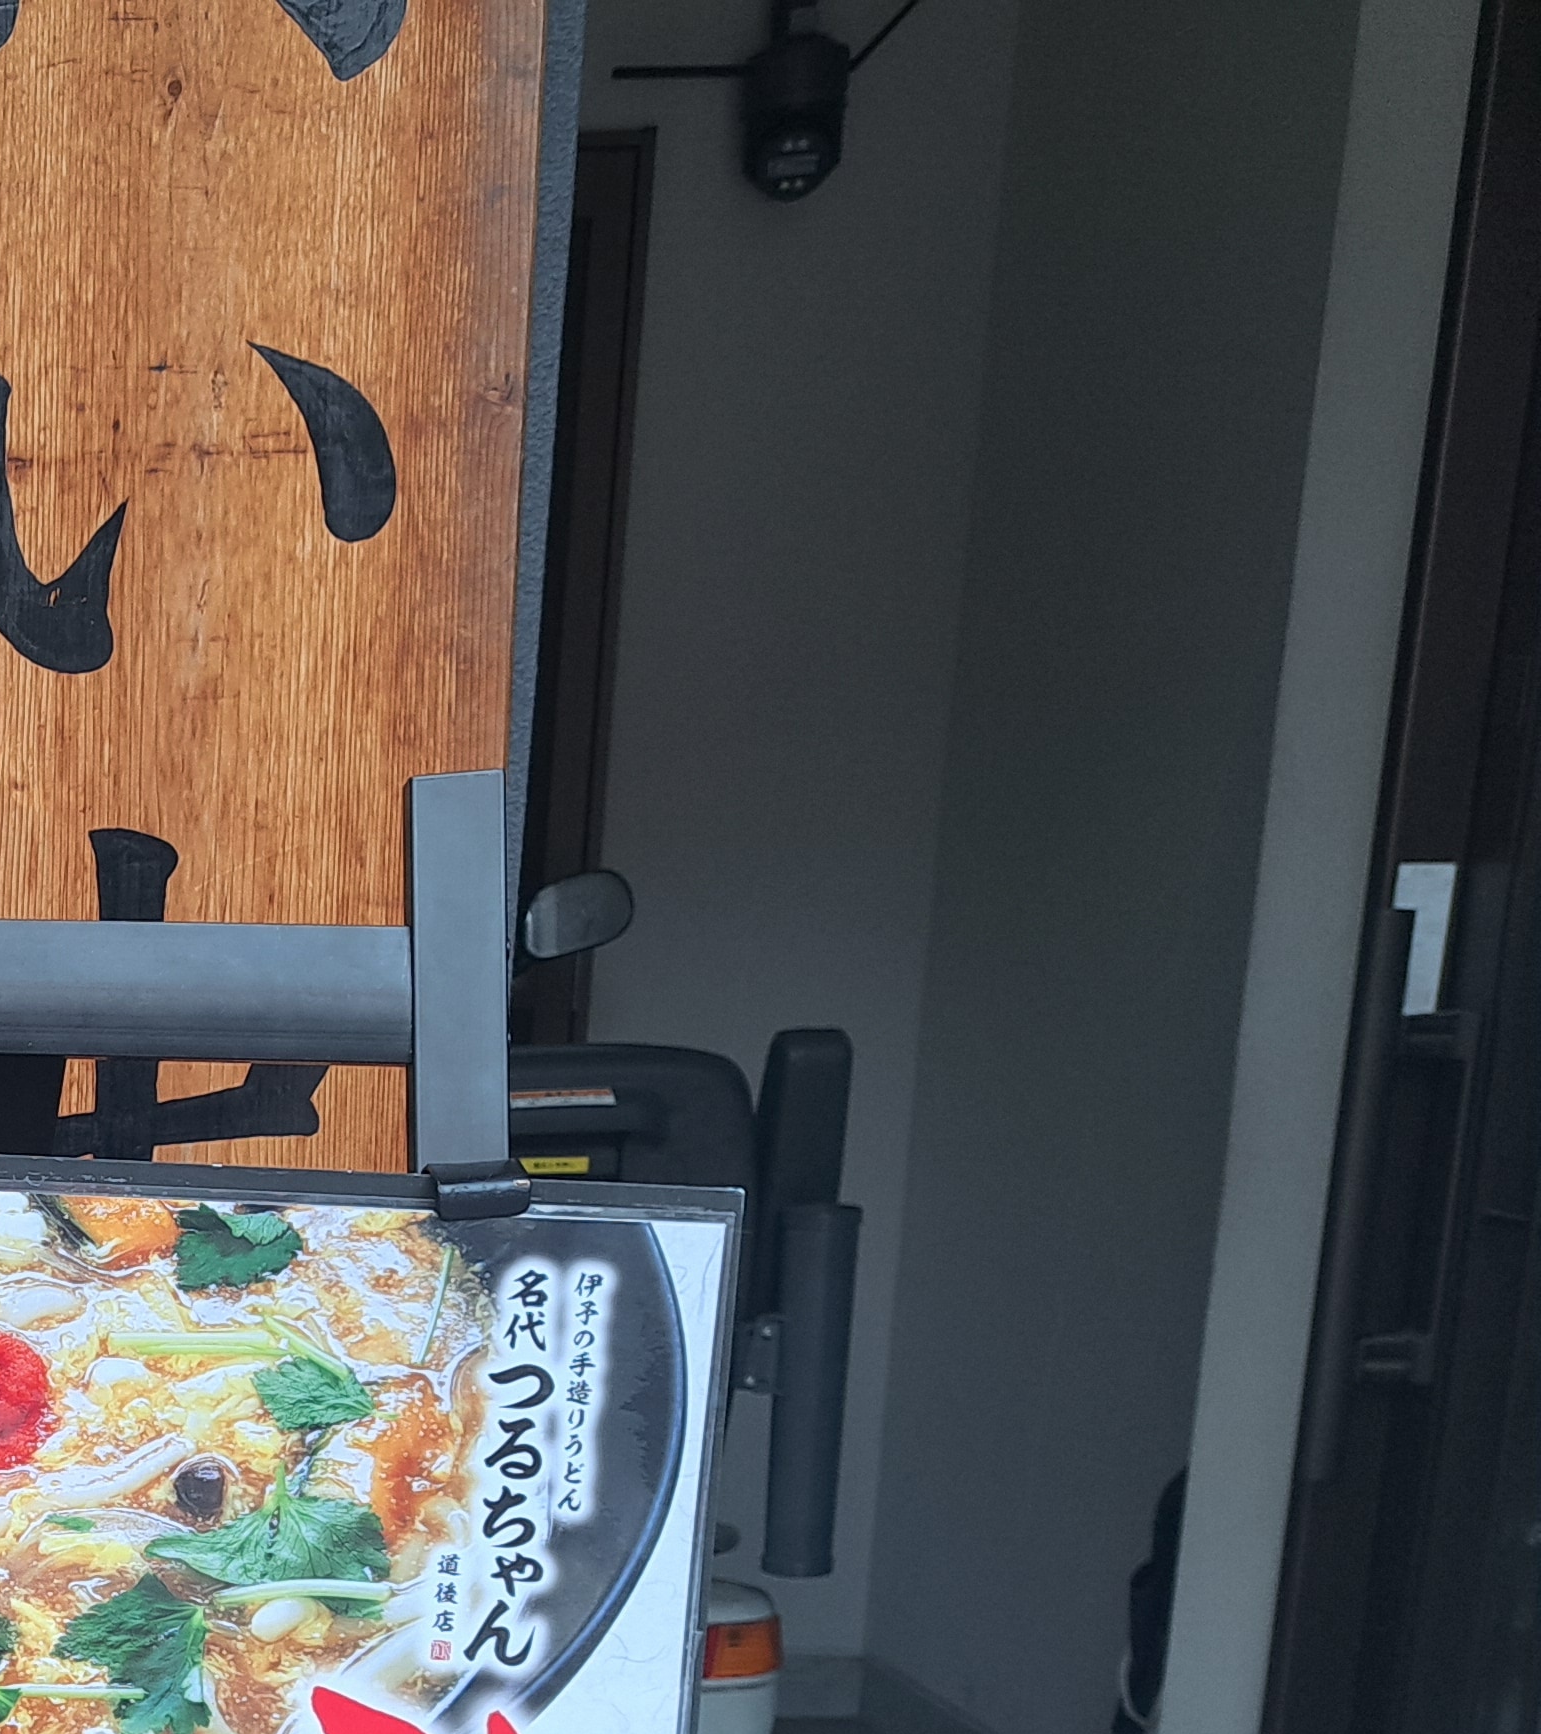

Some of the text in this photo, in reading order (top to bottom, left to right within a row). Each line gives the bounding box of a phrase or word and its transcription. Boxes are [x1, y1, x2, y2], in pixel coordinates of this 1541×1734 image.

[556, 1272, 605, 1513] 伊予の手造りうどん
[432, 1554, 462, 1633] 道後店
